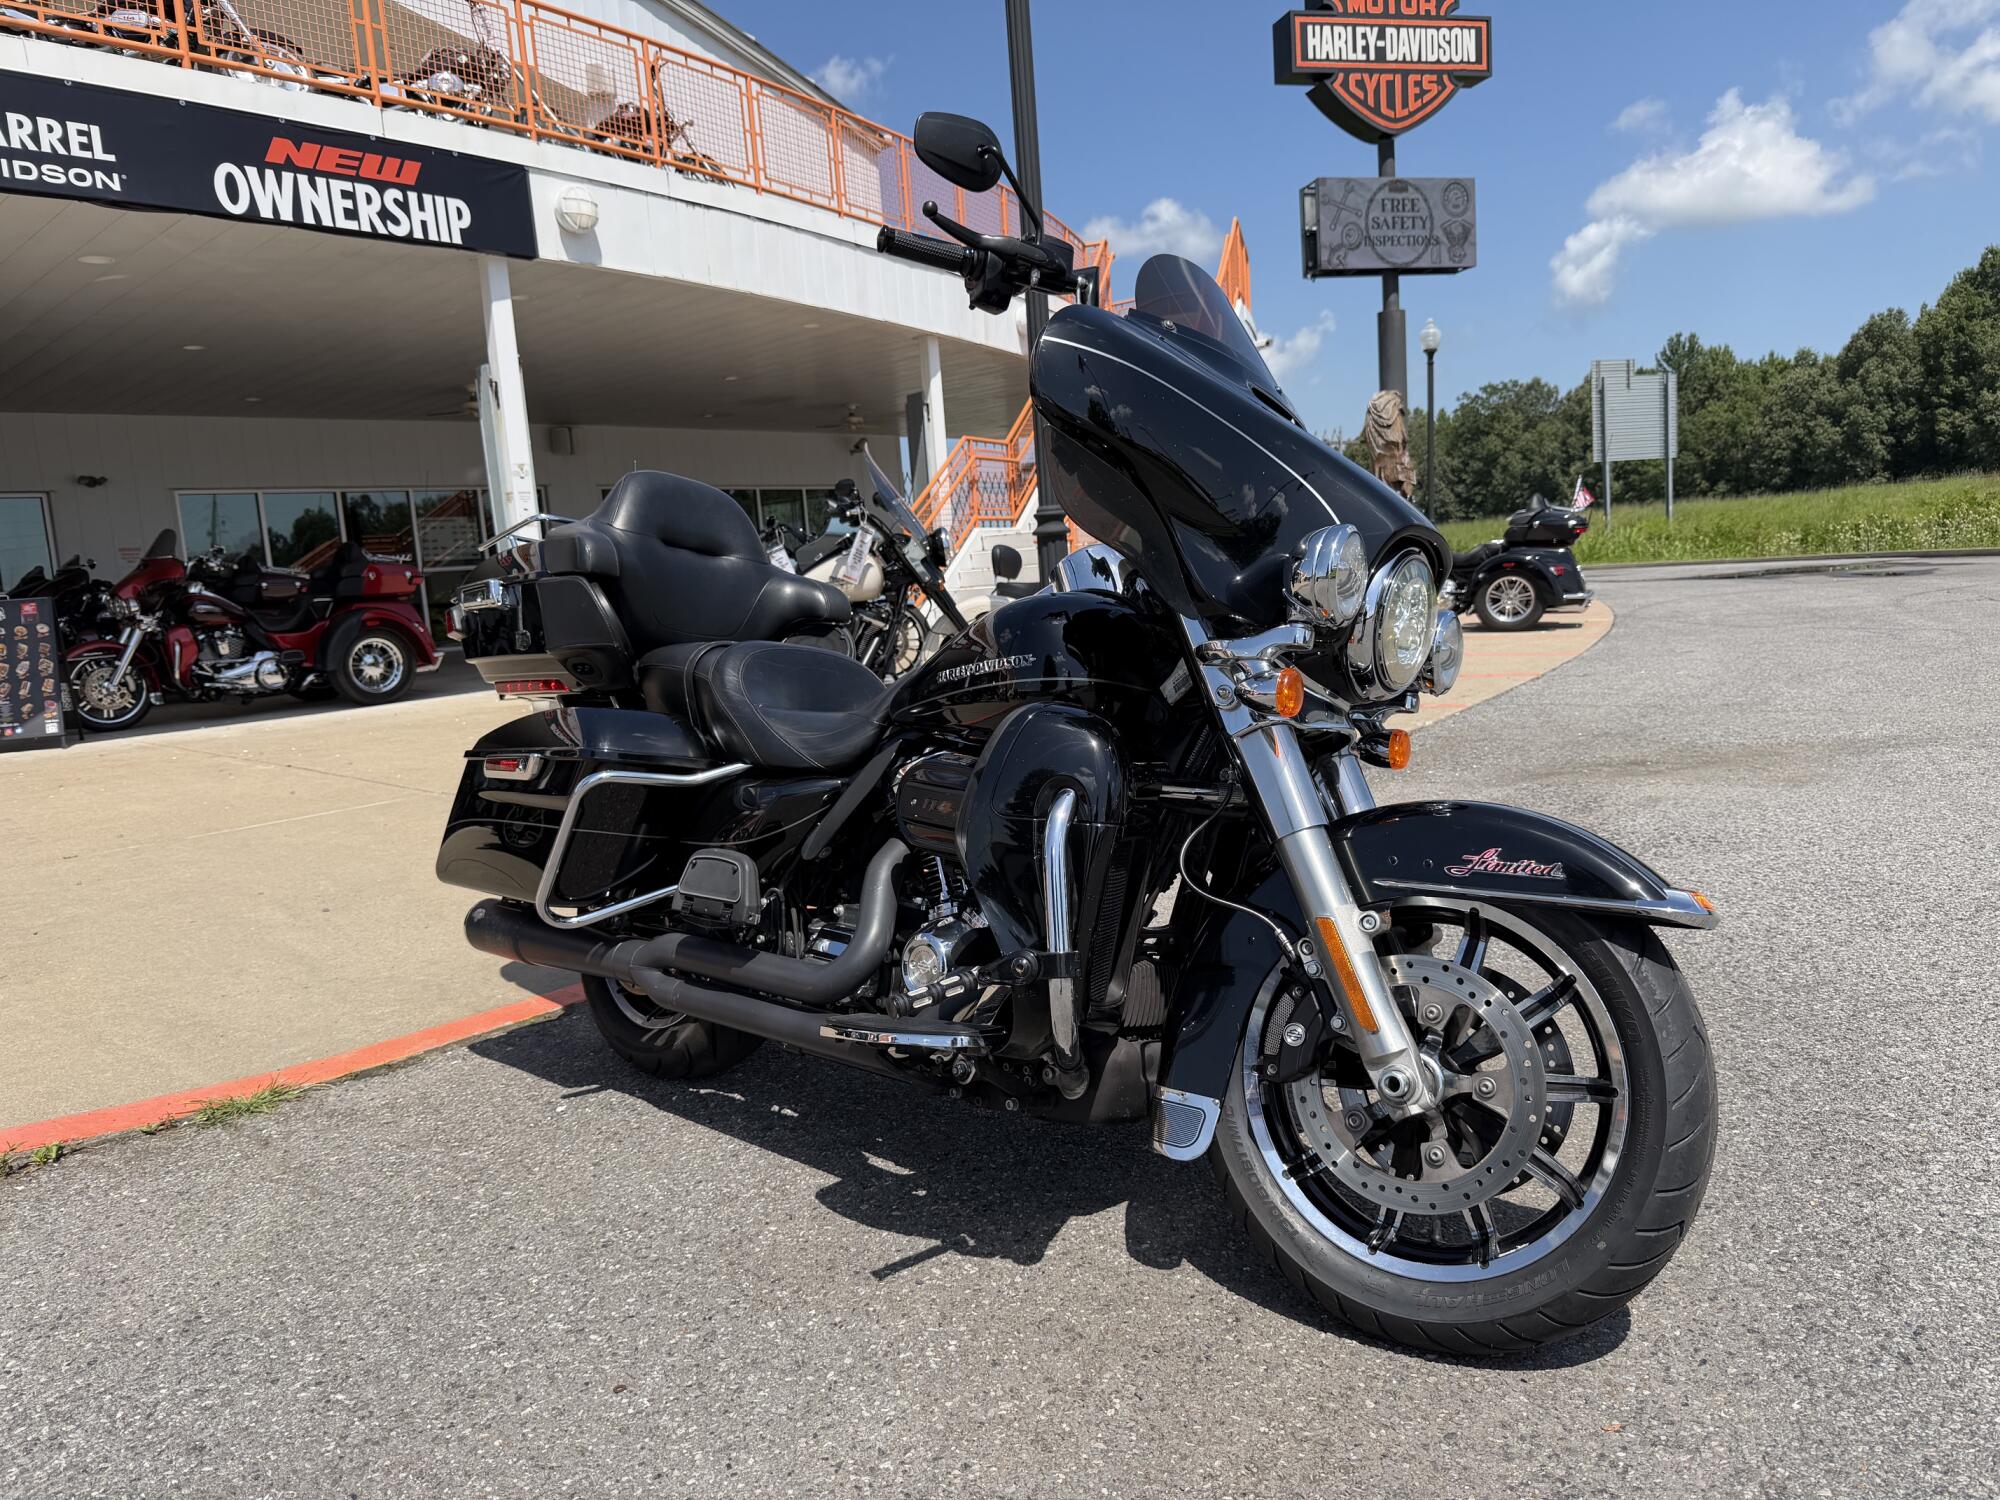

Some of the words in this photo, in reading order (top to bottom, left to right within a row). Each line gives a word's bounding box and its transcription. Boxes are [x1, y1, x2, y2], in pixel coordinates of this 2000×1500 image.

[1306, 24, 1476, 63] HARLEY-DAVIDSON
[1348, 72, 1439, 119] CYCLES
[264, 136, 423, 186] NEW
[213, 161, 472, 246] OWNERSHIP
[1380, 198, 1421, 213] FREE
[1371, 216, 1429, 231] SAFETY
[1364, 235, 1441, 248] INSPECTIONS
[936, 653, 1037, 684] HARLEY-DAVIDSON
[1443, 847, 1567, 881] Limited
